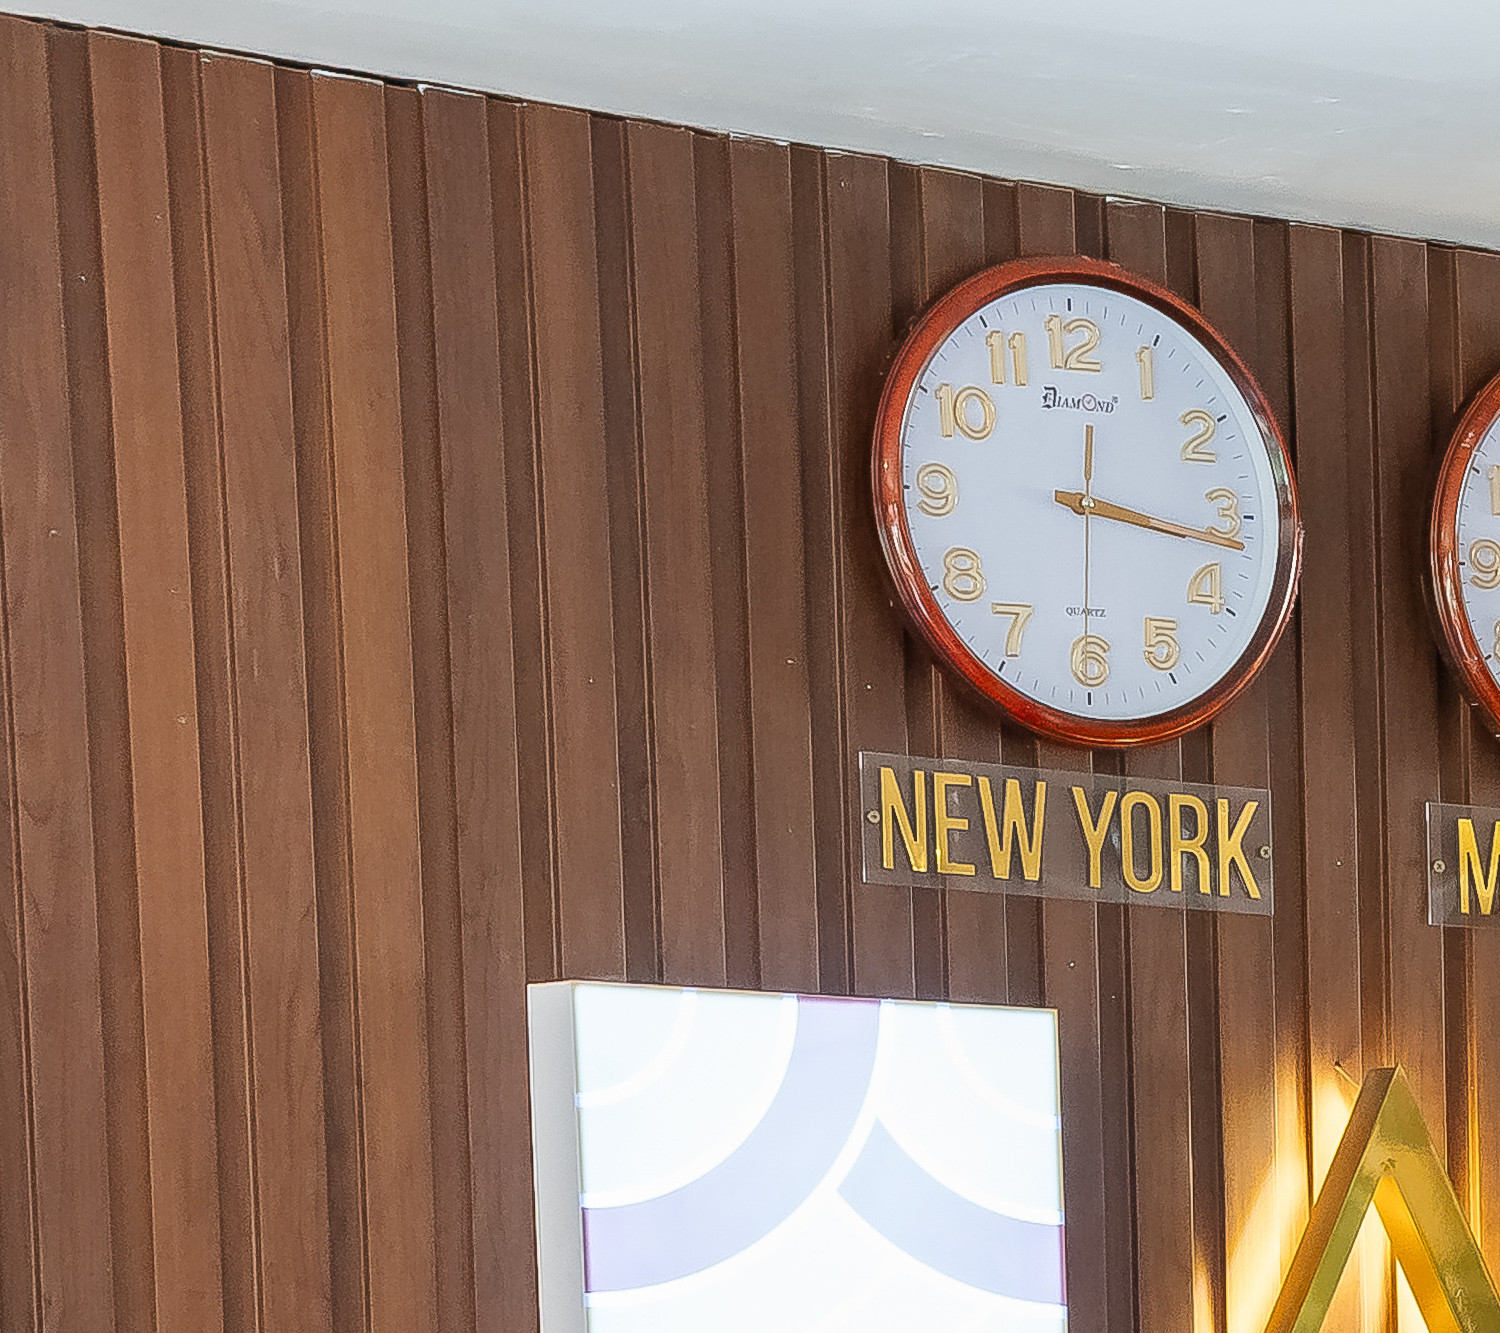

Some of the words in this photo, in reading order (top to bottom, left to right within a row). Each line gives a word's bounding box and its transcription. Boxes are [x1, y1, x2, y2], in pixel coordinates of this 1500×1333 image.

[986, 330, 1028, 386] 11
[1045, 315, 1102, 373] 12
[1136, 346, 1154, 400] 1
[934, 383, 996, 441] 10
[1181, 409, 1217, 462] 2
[916, 463, 958, 517] 9
[1205, 488, 1240, 539] 3
[943, 547, 986, 602] 8
[1187, 563, 1225, 614] 4
[991, 602, 1033, 657] 7
[1066, 606, 1106, 618] QUARTZ
[1070, 634, 1110, 687] 6
[1144, 617, 1180, 672] 5
[880, 766, 1046, 881] NEW
[1072, 786, 1261, 899] YORK
